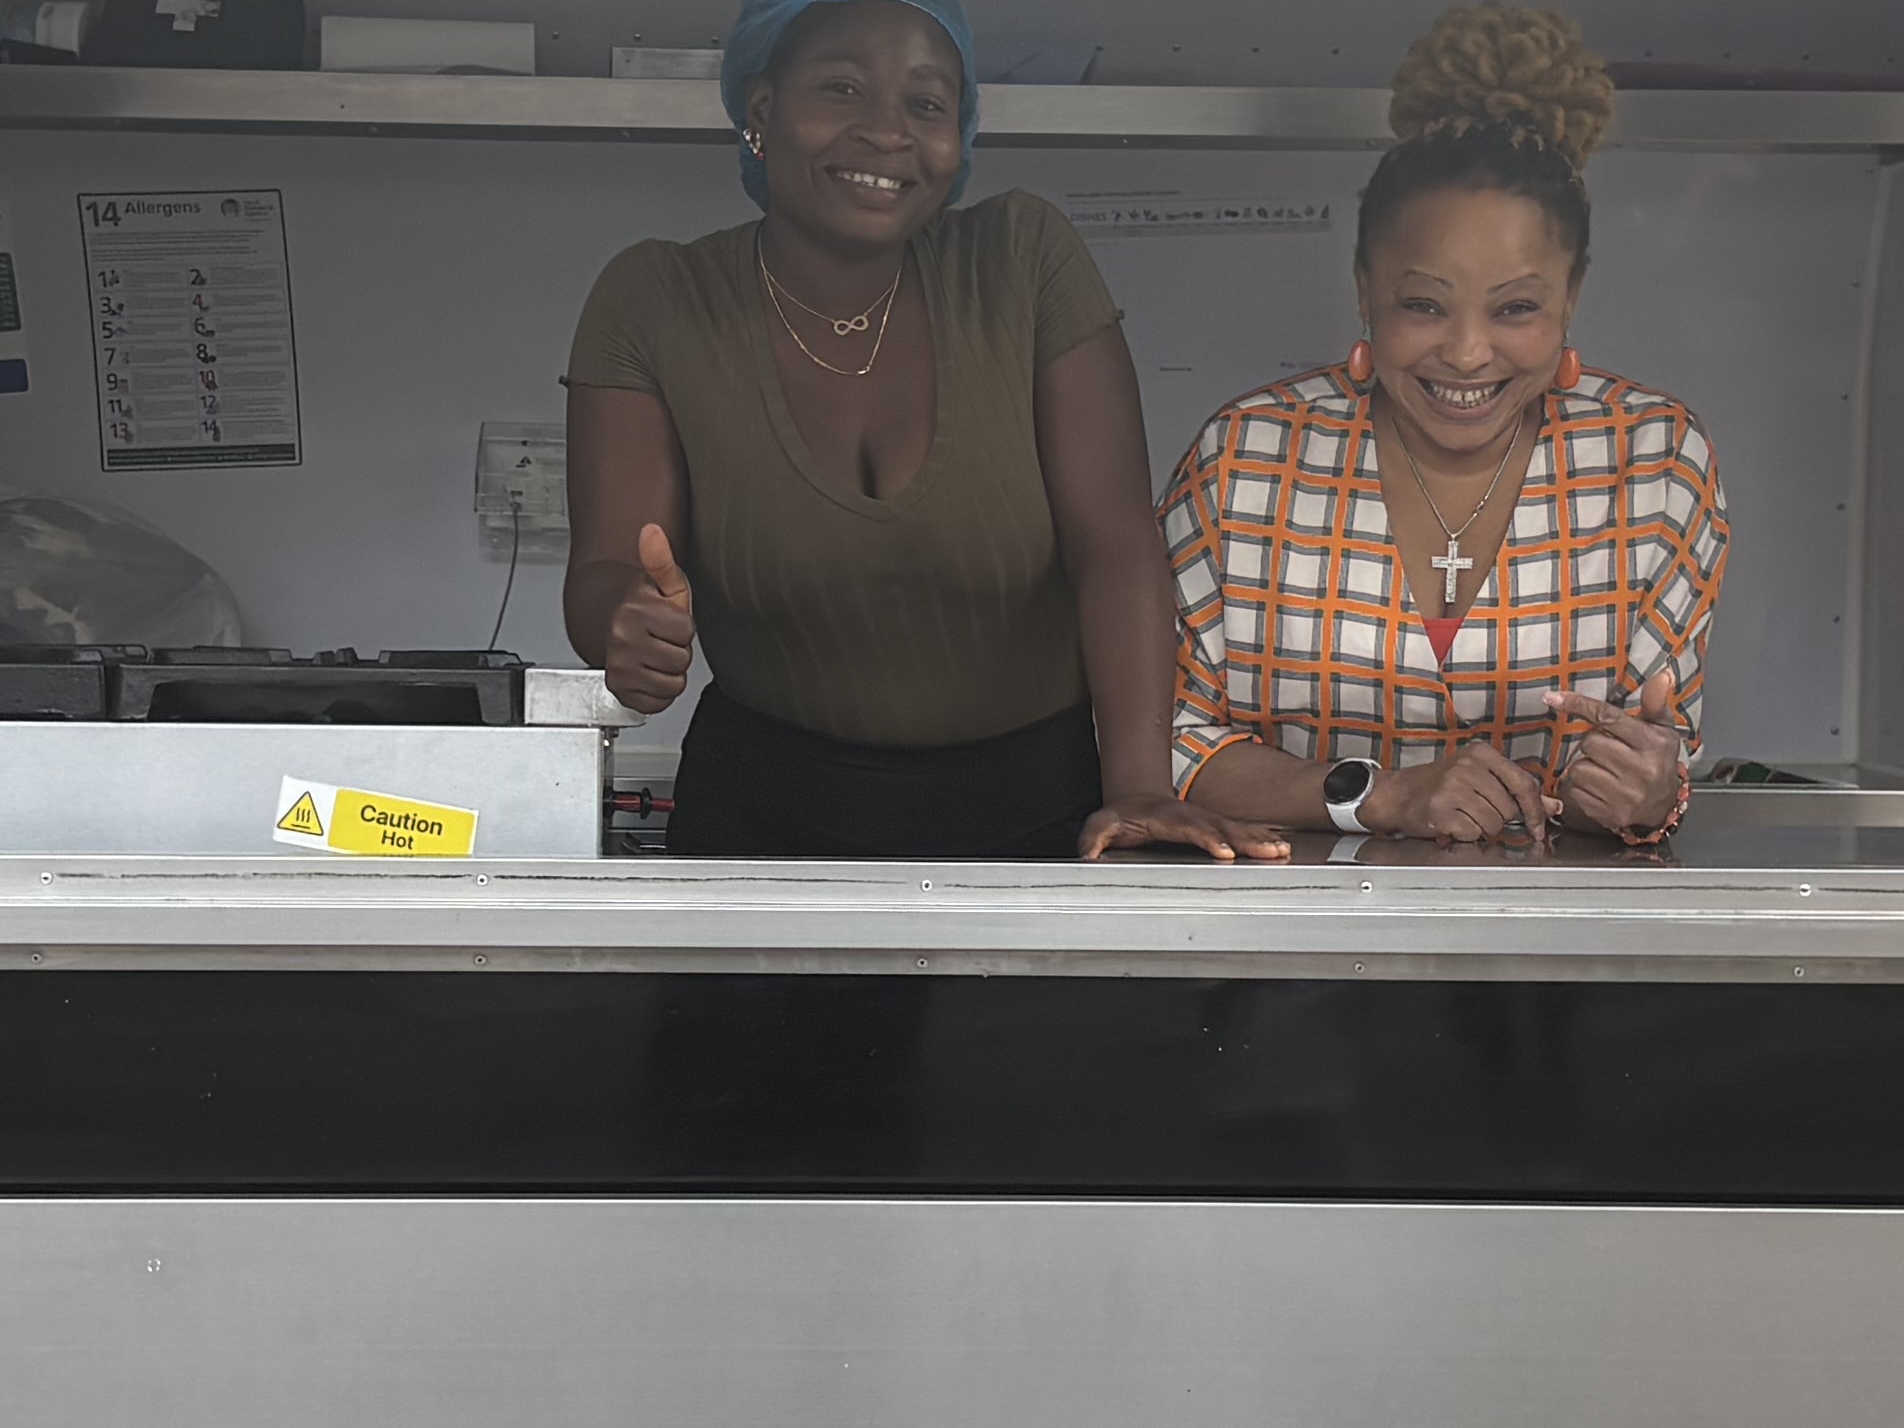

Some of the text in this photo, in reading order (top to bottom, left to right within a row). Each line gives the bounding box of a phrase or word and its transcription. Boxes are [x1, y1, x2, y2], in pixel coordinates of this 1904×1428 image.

[85, 201, 201, 227] 14 Allergens
[98, 271, 108, 287] 1
[190, 269, 202, 285] 2
[100, 297, 112, 314] 3
[192, 294, 204, 311] 4
[102, 322, 113, 338] 5
[194, 317, 206, 335] 6
[104, 348, 115, 365] 7
[196, 344, 208, 362] 8
[107, 374, 118, 390] 9
[200, 370, 216, 390] 10
[108, 399, 122, 413] 11
[200, 395, 216, 413] 12
[110, 424, 128, 440] 13
[202, 421, 218, 435] 14
[360, 804, 443, 836] Caution
[381, 830, 414, 850] Hot
